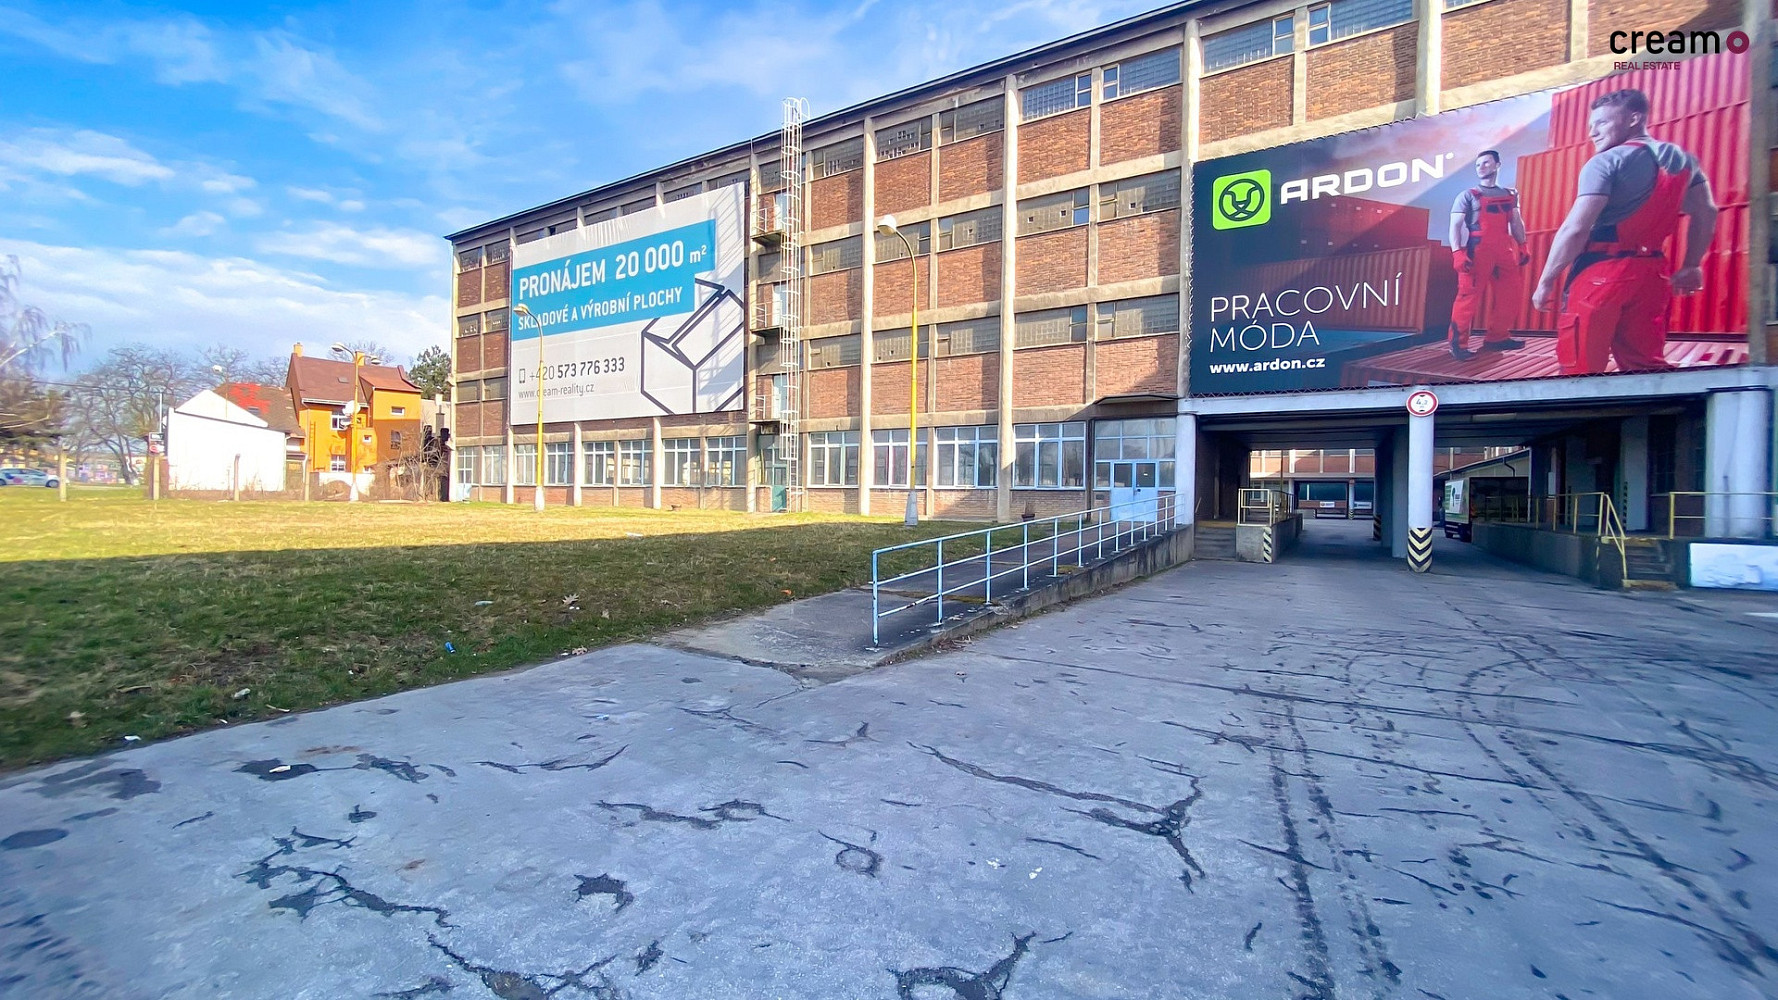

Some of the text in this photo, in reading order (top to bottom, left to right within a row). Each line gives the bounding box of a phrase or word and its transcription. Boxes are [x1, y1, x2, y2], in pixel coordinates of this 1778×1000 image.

[1280, 153, 1444, 205] ARDON
[519, 259, 606, 300] PRONÁJEM
[615, 253, 639, 280] 20
[644, 240, 684, 274] 000
[518, 286, 683, 331] SKLADOVÉ A VÝROBNÍ PLOCHY
[1211, 272, 1402, 322] PRACOVNÍ
[1210, 319, 1320, 352] MÓDA
[557, 363, 577, 379] 573
[580, 359, 600, 376] 776
[603, 356, 625, 373] 333
[1210, 357, 1326, 374] www.ardon.cz
[518, 383, 595, 399] www.ceam-reality.cz
